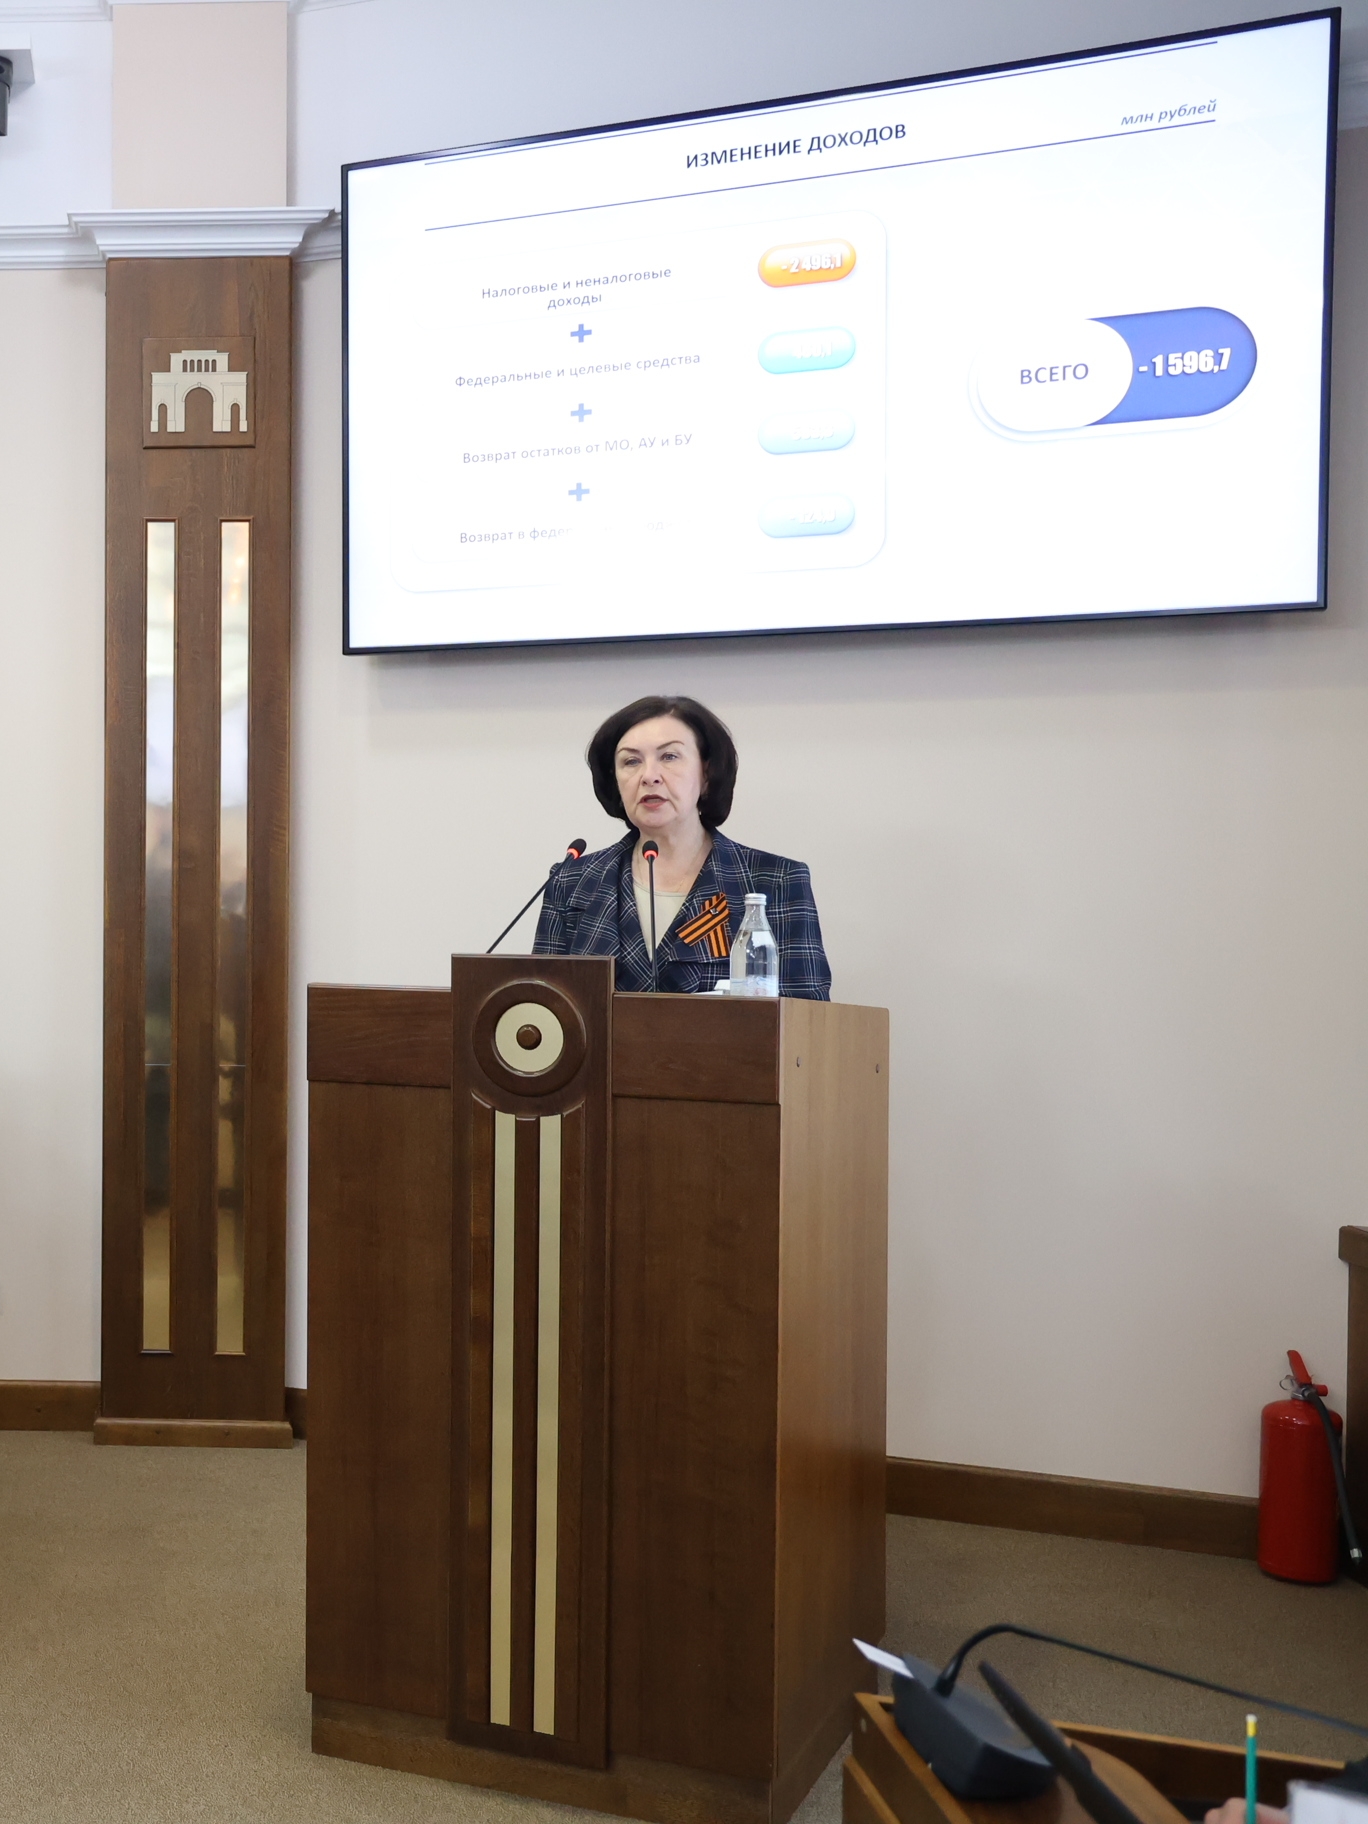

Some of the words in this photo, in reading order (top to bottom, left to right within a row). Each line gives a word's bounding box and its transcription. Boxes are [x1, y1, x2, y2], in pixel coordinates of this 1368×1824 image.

[1120, 112, 1154, 126] млн
[1157, 98, 1217, 123] рублей
[686, 138, 802, 169] ИЗМЕНЕНИЕ
[807, 123, 907, 155] ДОХОДОВ
[481, 280, 558, 299] Налоговые
[562, 280, 571, 290] и
[575, 267, 672, 288] неналоговые
[547, 293, 602, 310] доходы
[455, 367, 552, 388] Федеральные
[556, 367, 565, 378] и
[569, 360, 632, 378] целевые
[636, 353, 701, 372] средства
[1020, 363, 1089, 385] ВСЕГО
[462, 449, 517, 464] Возврат
[521, 445, 581, 460] остатков
[585, 443, 600, 453] от
[638, 436, 656, 449] АУ
[661, 437, 670, 447] и
[674, 433, 693, 446] БУ
[459, 530, 514, 544] Возврат
[517, 529, 525, 540] в
